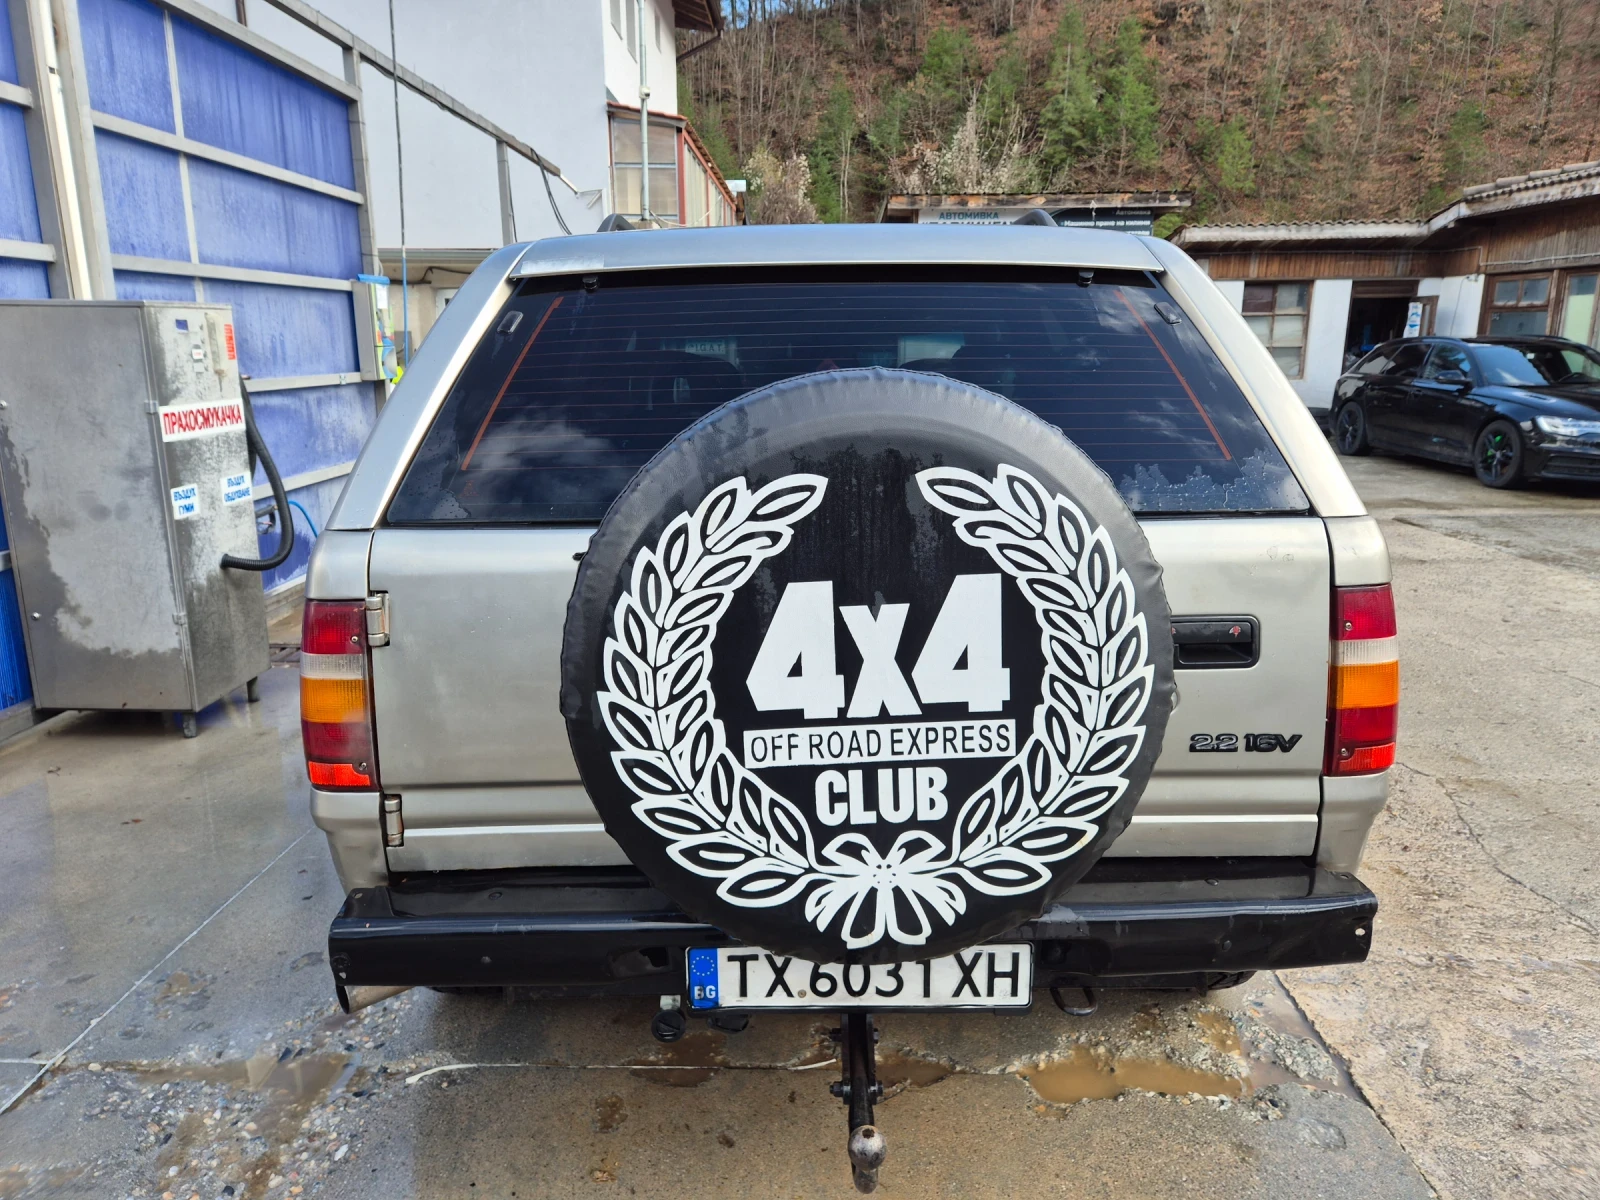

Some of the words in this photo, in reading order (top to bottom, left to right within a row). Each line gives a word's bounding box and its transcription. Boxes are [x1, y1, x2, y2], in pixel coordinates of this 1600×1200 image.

[939, 211, 999, 220] АВТОМИВКА
[163, 404, 243, 435] ПРАХОСМУКАЧКА
[173, 487, 196, 502] ВЪЗДУХ
[178, 502, 195, 515] ГУМИ
[745, 573, 1011, 720] 4x4
[750, 733, 799, 763] OFF
[809, 729, 881, 760] ROAD
[890, 723, 1011, 756] EXPRESS
[1243, 733, 1303, 753] 16V
[814, 766, 949, 827] CLUB
[694, 985, 716, 999] BG
[809, 961, 932, 999] 6031
